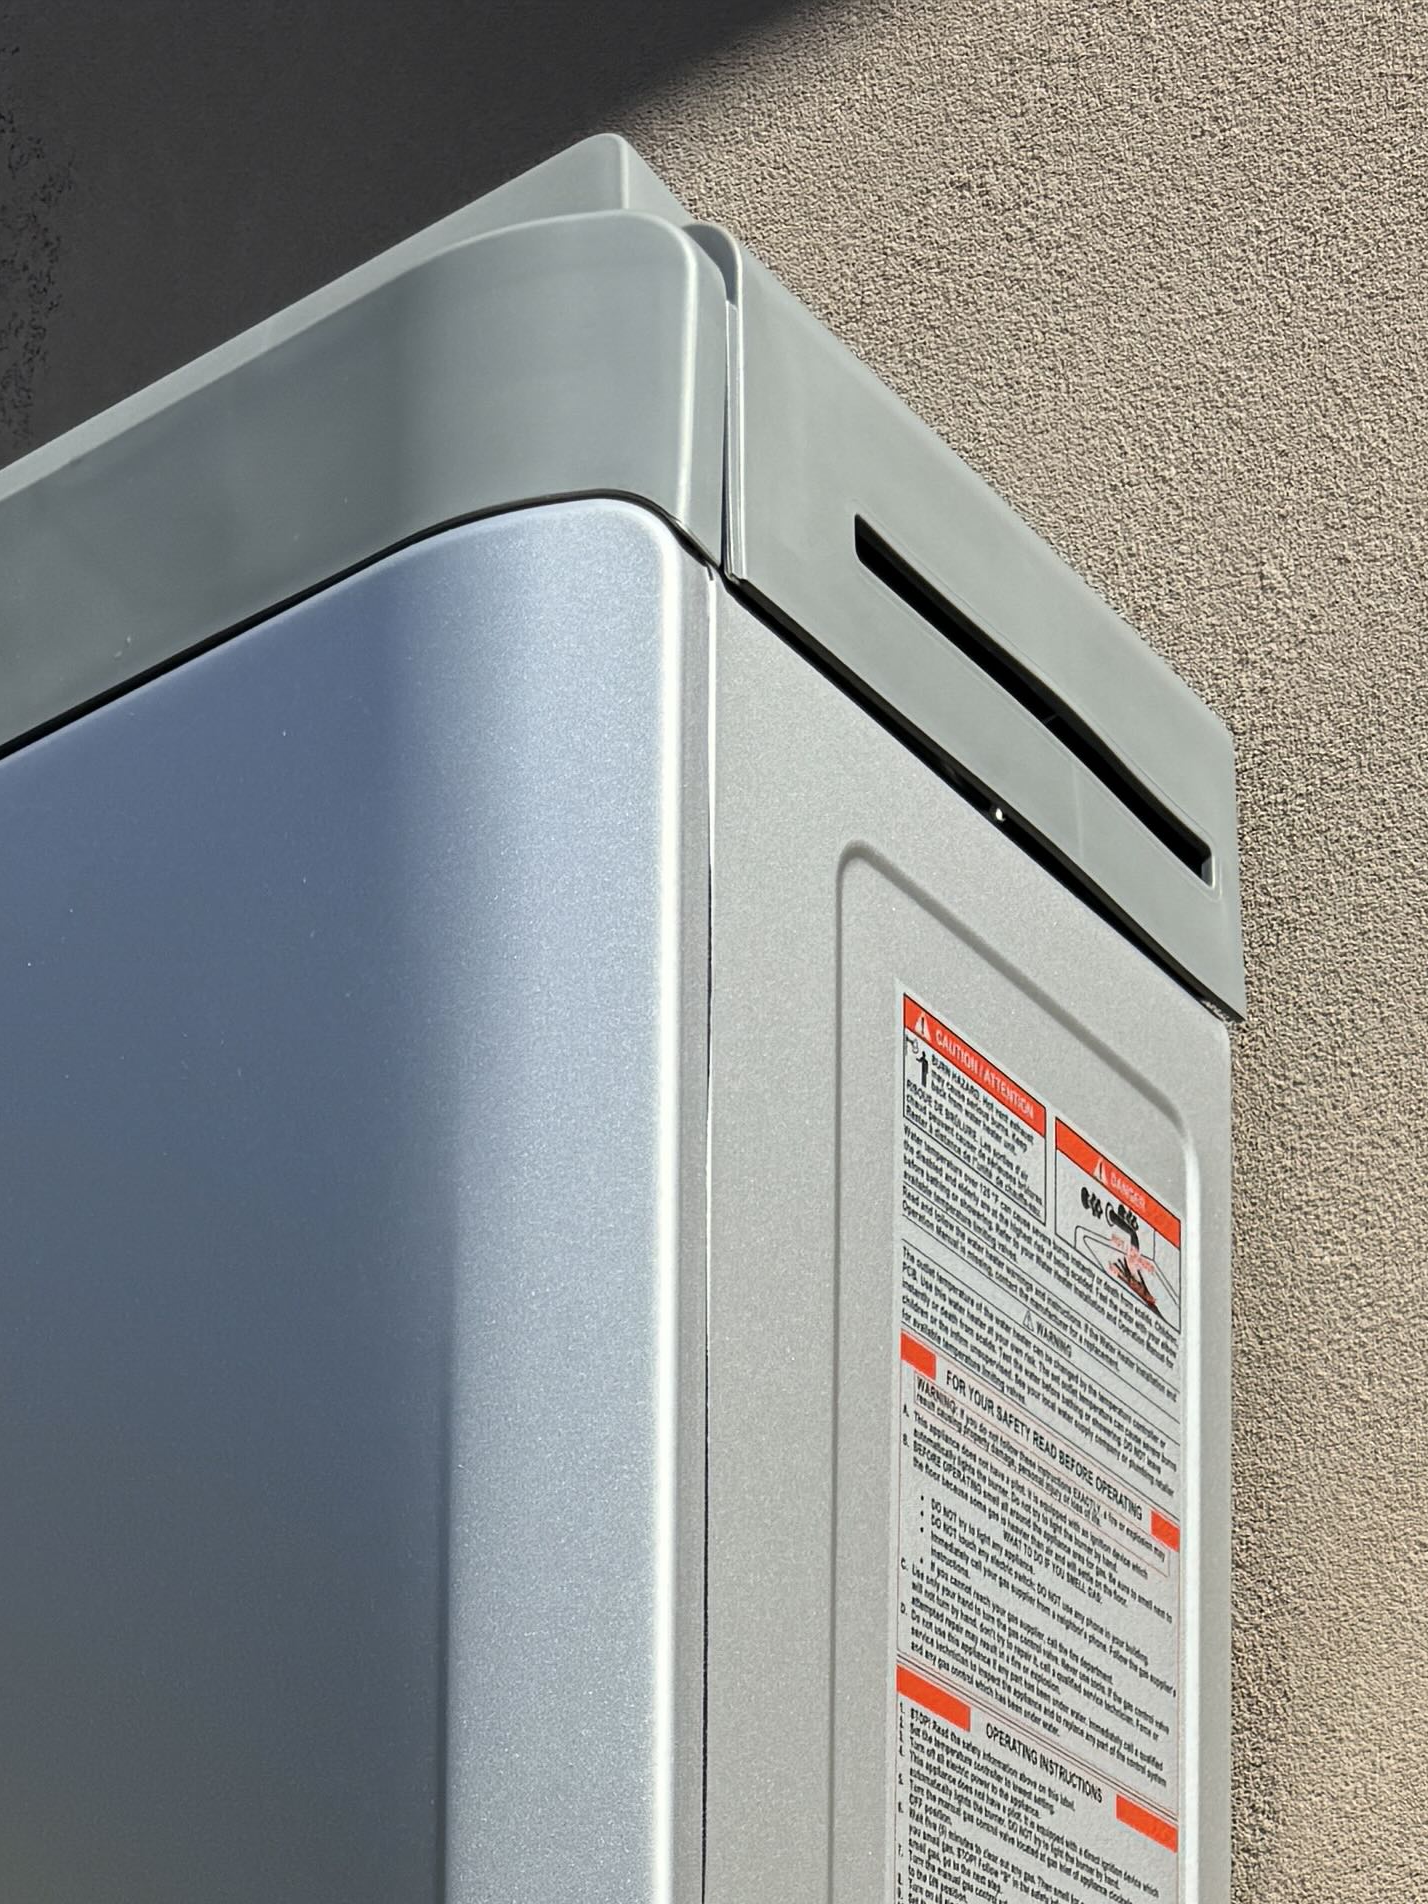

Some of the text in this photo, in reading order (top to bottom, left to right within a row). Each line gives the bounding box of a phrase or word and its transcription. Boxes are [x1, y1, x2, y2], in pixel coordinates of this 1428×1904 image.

[935, 1029, 1034, 1120] CAUTION ATTENTION
[946, 1369, 1143, 1521] FOR YOUR SAFETY READ BEFORE OPERATING
[986, 1722, 1103, 1804] OPERATING INSTRUCTIONS
